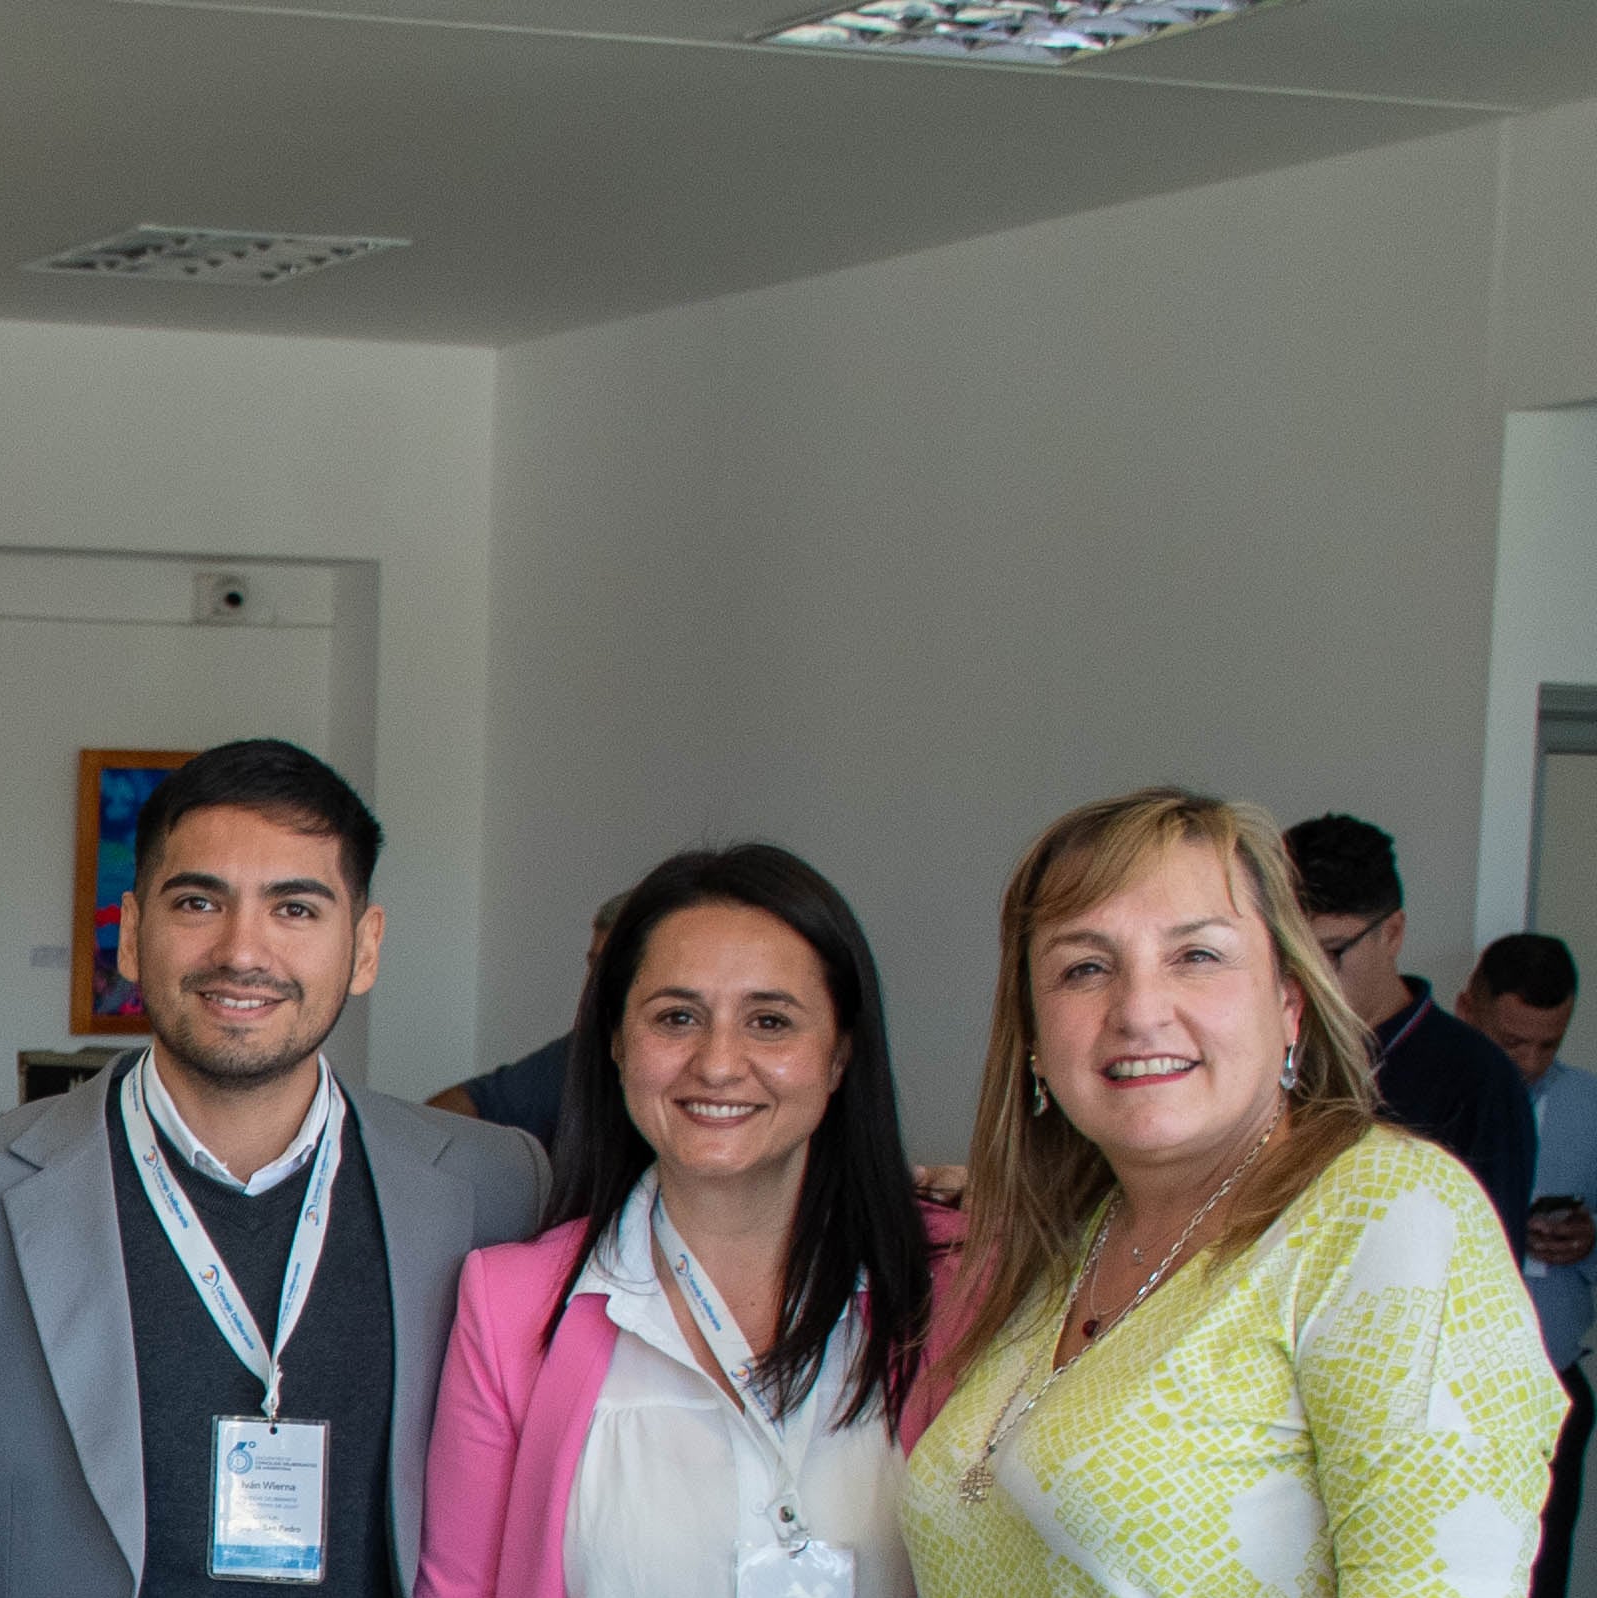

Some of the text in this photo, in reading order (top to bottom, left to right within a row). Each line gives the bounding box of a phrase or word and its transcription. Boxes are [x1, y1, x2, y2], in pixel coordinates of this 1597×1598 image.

[215, 1286, 255, 1351] Concejo Deliberante
[241, 1479, 296, 1492] Iván Wierna
